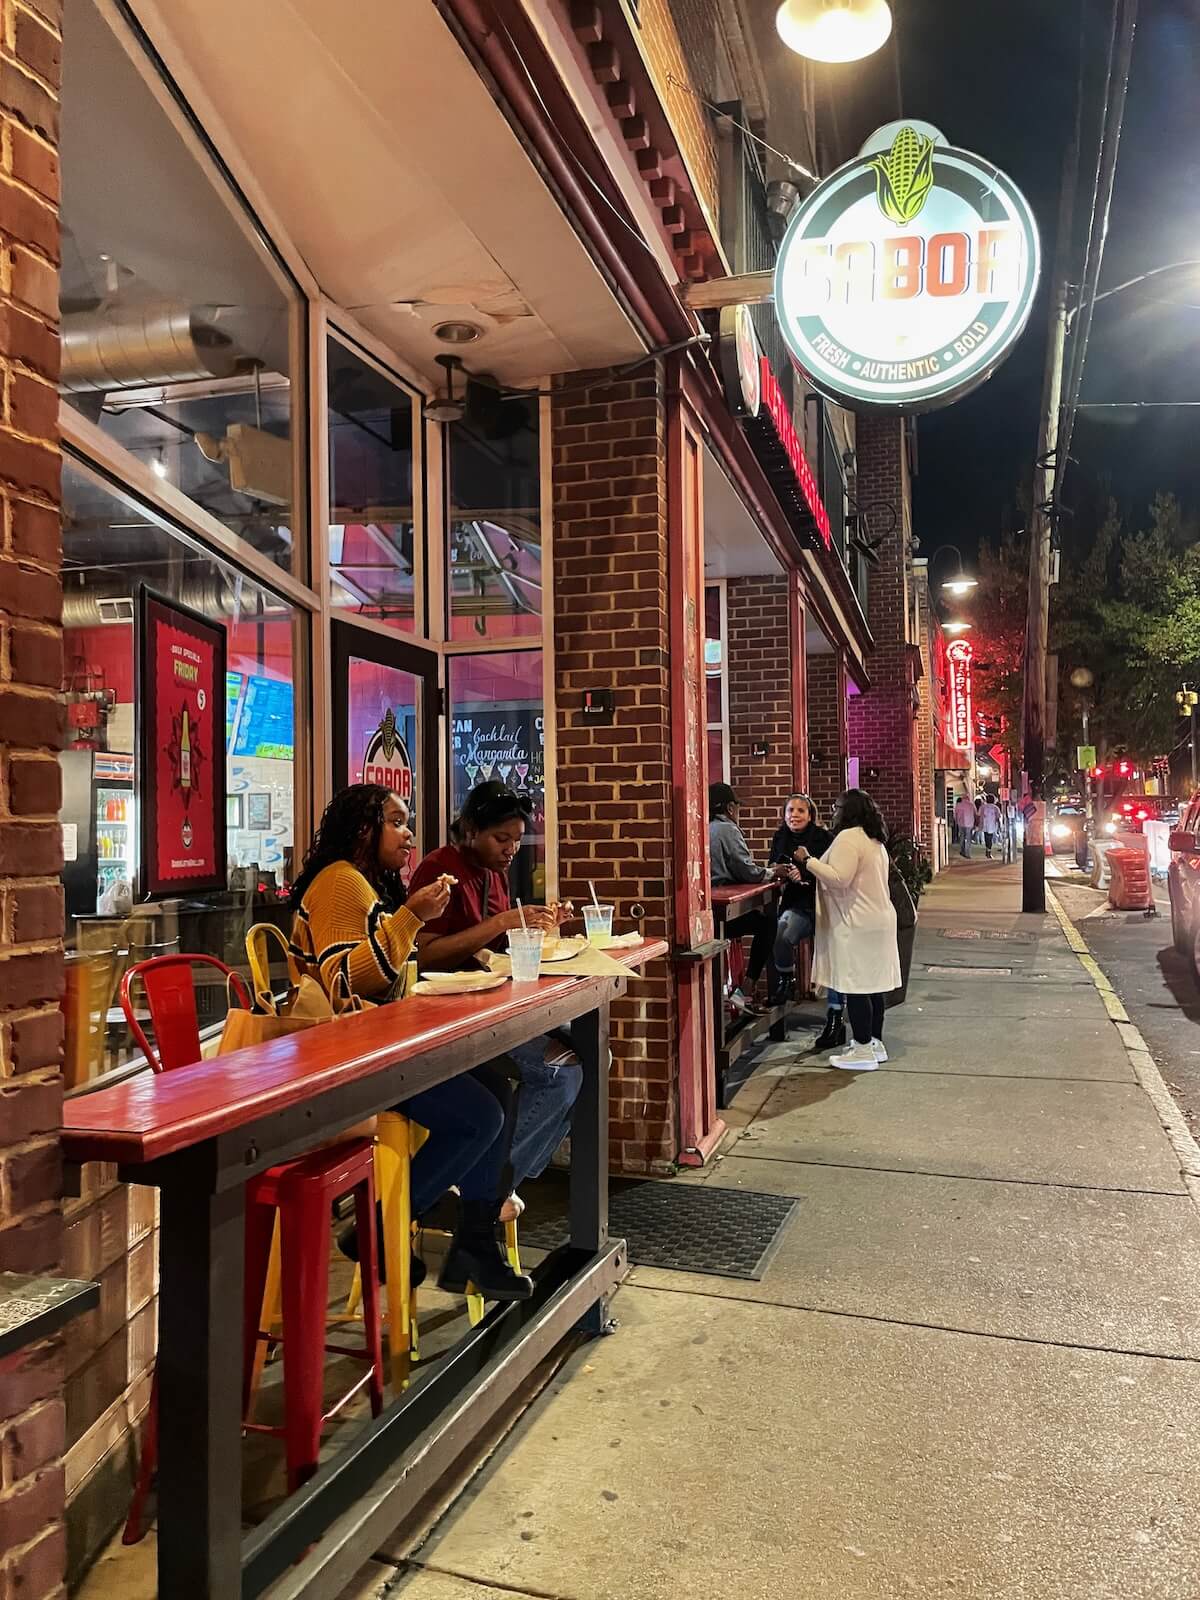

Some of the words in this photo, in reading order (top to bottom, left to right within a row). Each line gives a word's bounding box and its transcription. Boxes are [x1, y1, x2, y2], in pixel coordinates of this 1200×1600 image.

[811, 334, 850, 369] FRESH
[860, 356, 940, 380] AUTHENTIC
[953, 321, 988, 357] BOLD
[173, 659, 199, 683] FRIDAY
[473, 724, 522, 745] Cocktail
[460, 743, 528, 766] Margarita
[366, 765, 411, 797] SABOR
